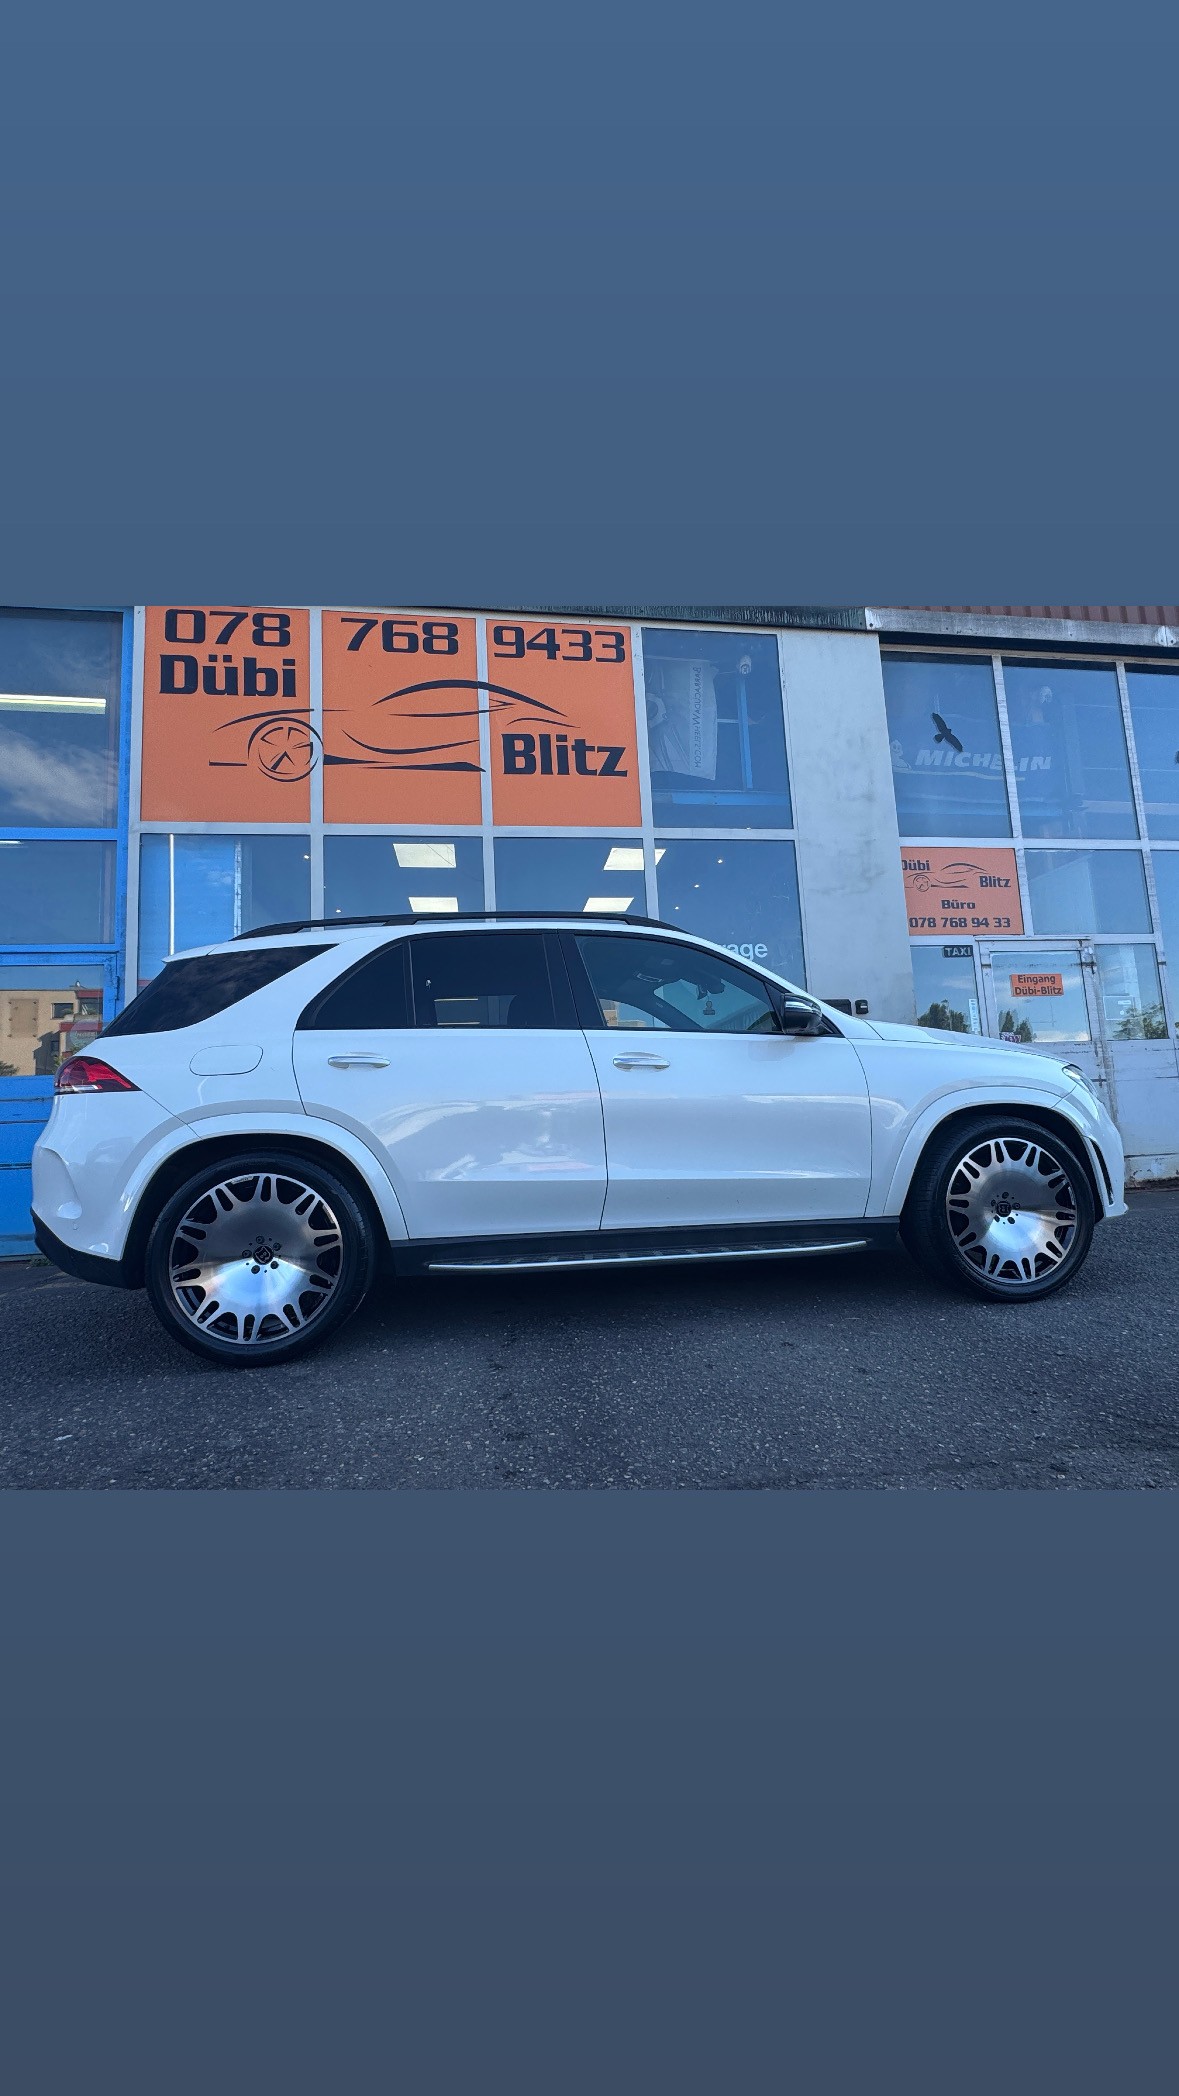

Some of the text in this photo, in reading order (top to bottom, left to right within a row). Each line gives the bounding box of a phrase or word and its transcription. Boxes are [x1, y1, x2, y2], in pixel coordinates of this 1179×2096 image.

[164, 608, 626, 664] 078 768 9433
[159, 653, 297, 698] Dübi
[501, 733, 629, 778] Blitz
[915, 749, 1052, 772] MICHEIN
[979, 875, 1012, 888] Blitz
[941, 899, 976, 910] Büro
[909, 917, 1011, 928] 078 768 94 33
[944, 945, 972, 956] TAXI
[1017, 974, 1056, 985] Eingang
[1014, 986, 1063, 995] Dübi-Blitz
